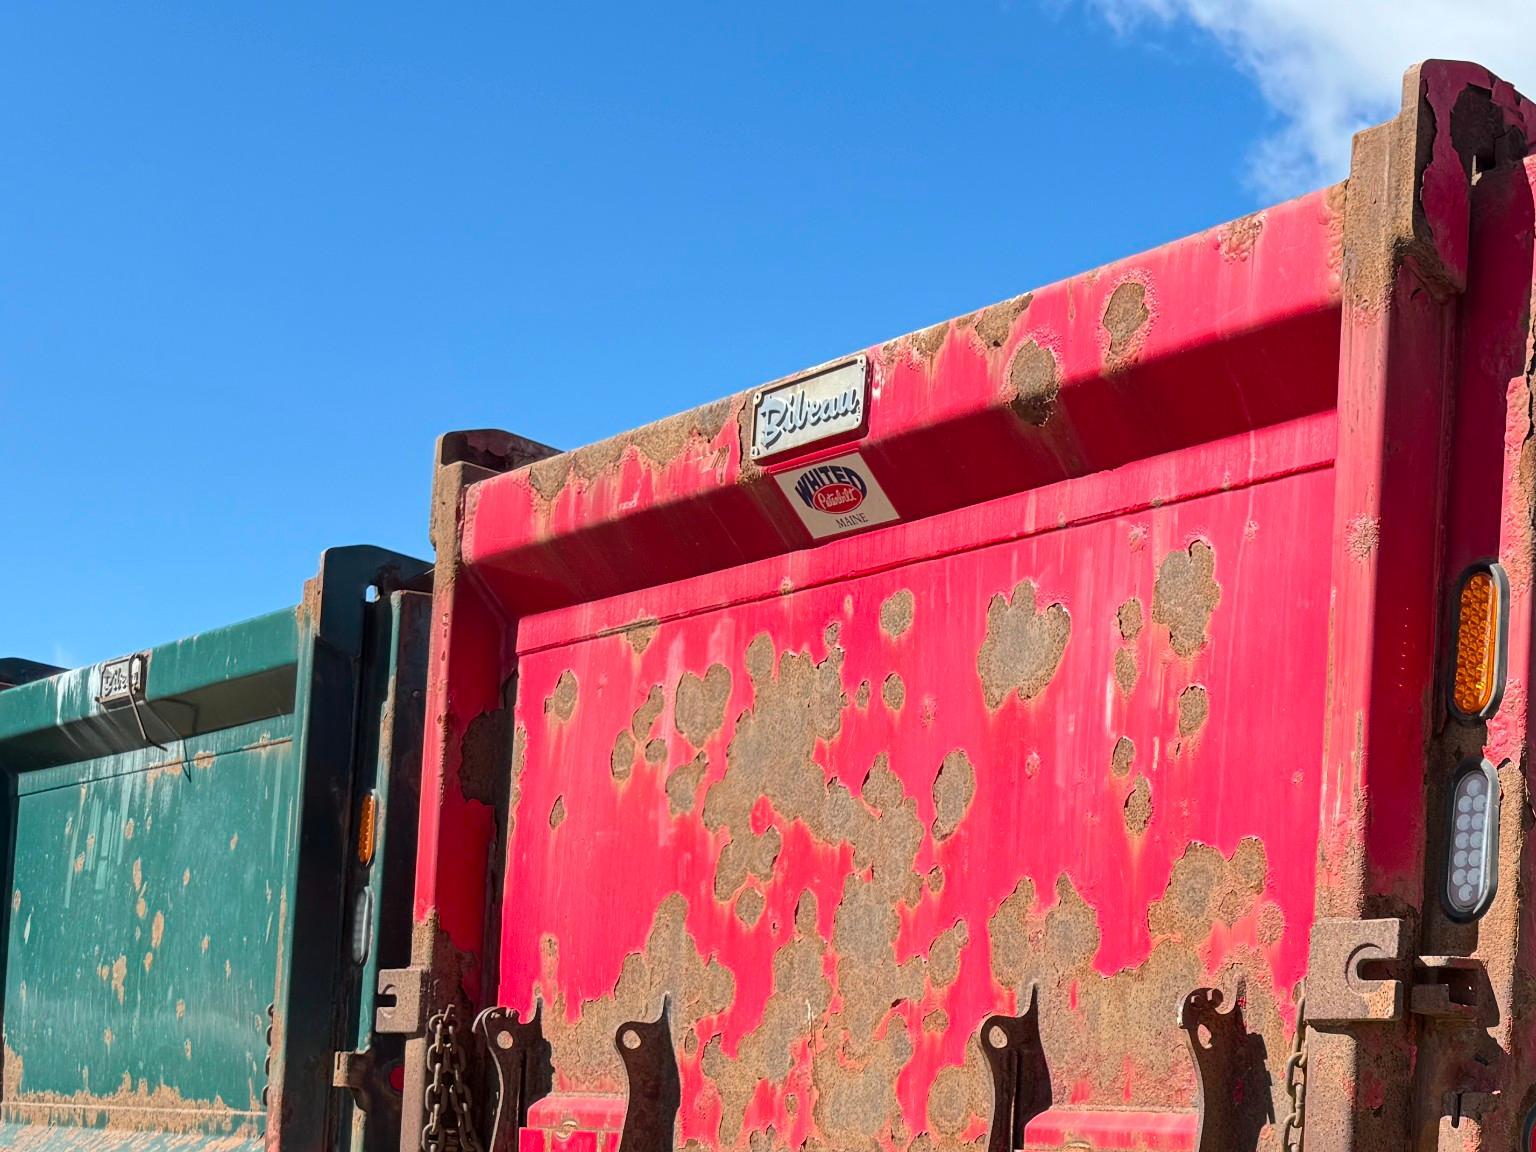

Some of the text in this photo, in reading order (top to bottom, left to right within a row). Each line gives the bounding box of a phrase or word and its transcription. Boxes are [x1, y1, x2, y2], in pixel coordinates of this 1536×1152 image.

[794, 464, 868, 510] WHITED
[816, 485, 858, 510] Peterbilt
[834, 512, 869, 529] MAINE
